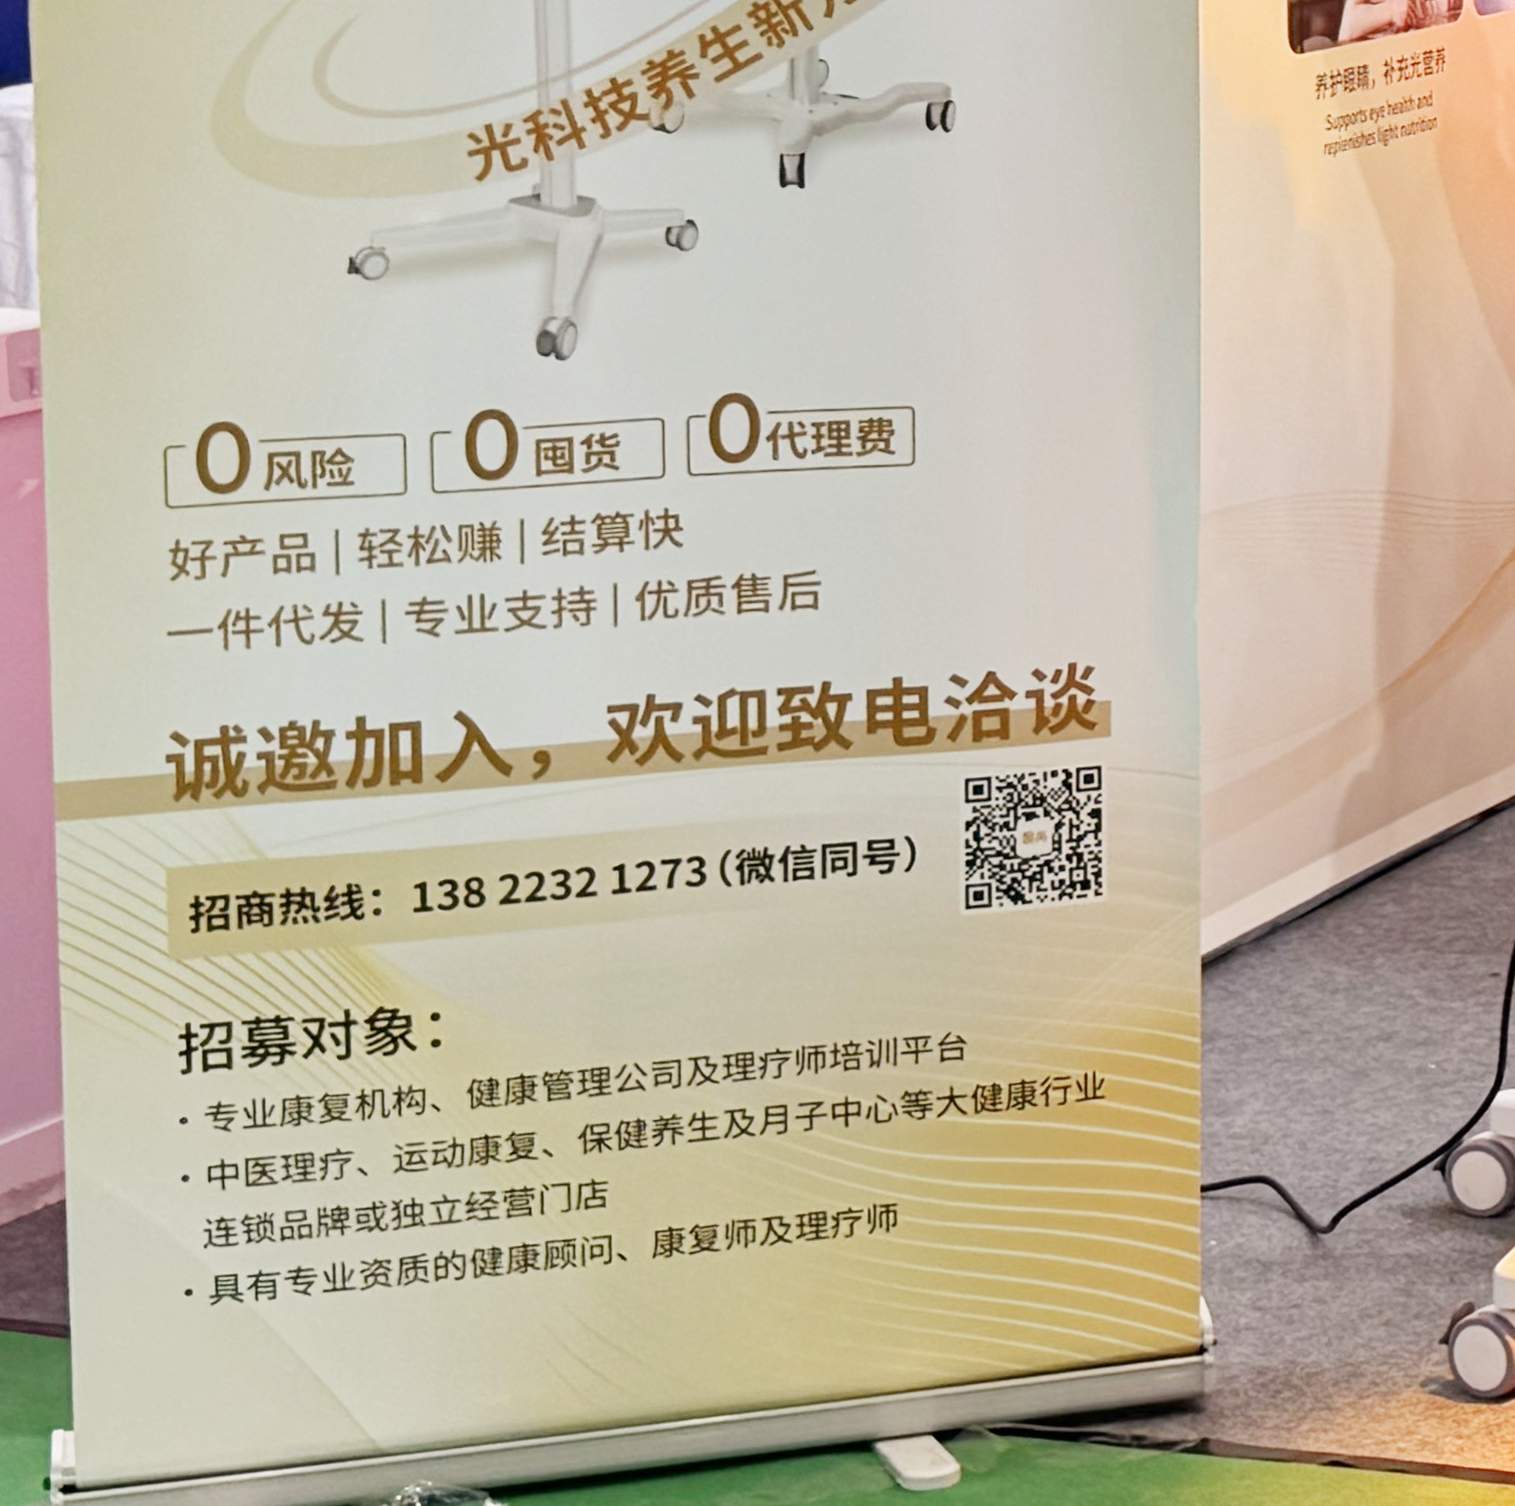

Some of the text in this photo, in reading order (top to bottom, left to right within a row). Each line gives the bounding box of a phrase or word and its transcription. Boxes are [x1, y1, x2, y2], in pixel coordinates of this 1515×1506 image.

[1315, 46, 1446, 100] 养护眼睛，补充光营养
[1323, 115, 1438, 158] replenishes light nutrition
[1325, 89, 1434, 133] Supports eye health and
[164, 661, 1101, 806] 诚邀加入，欢迎致电洽谈
[498, 867, 598, 908] 2232
[176, 1003, 449, 1076] 招募对象：
[203, 1177, 611, 1251] 连锁品牌或独立经营门店
